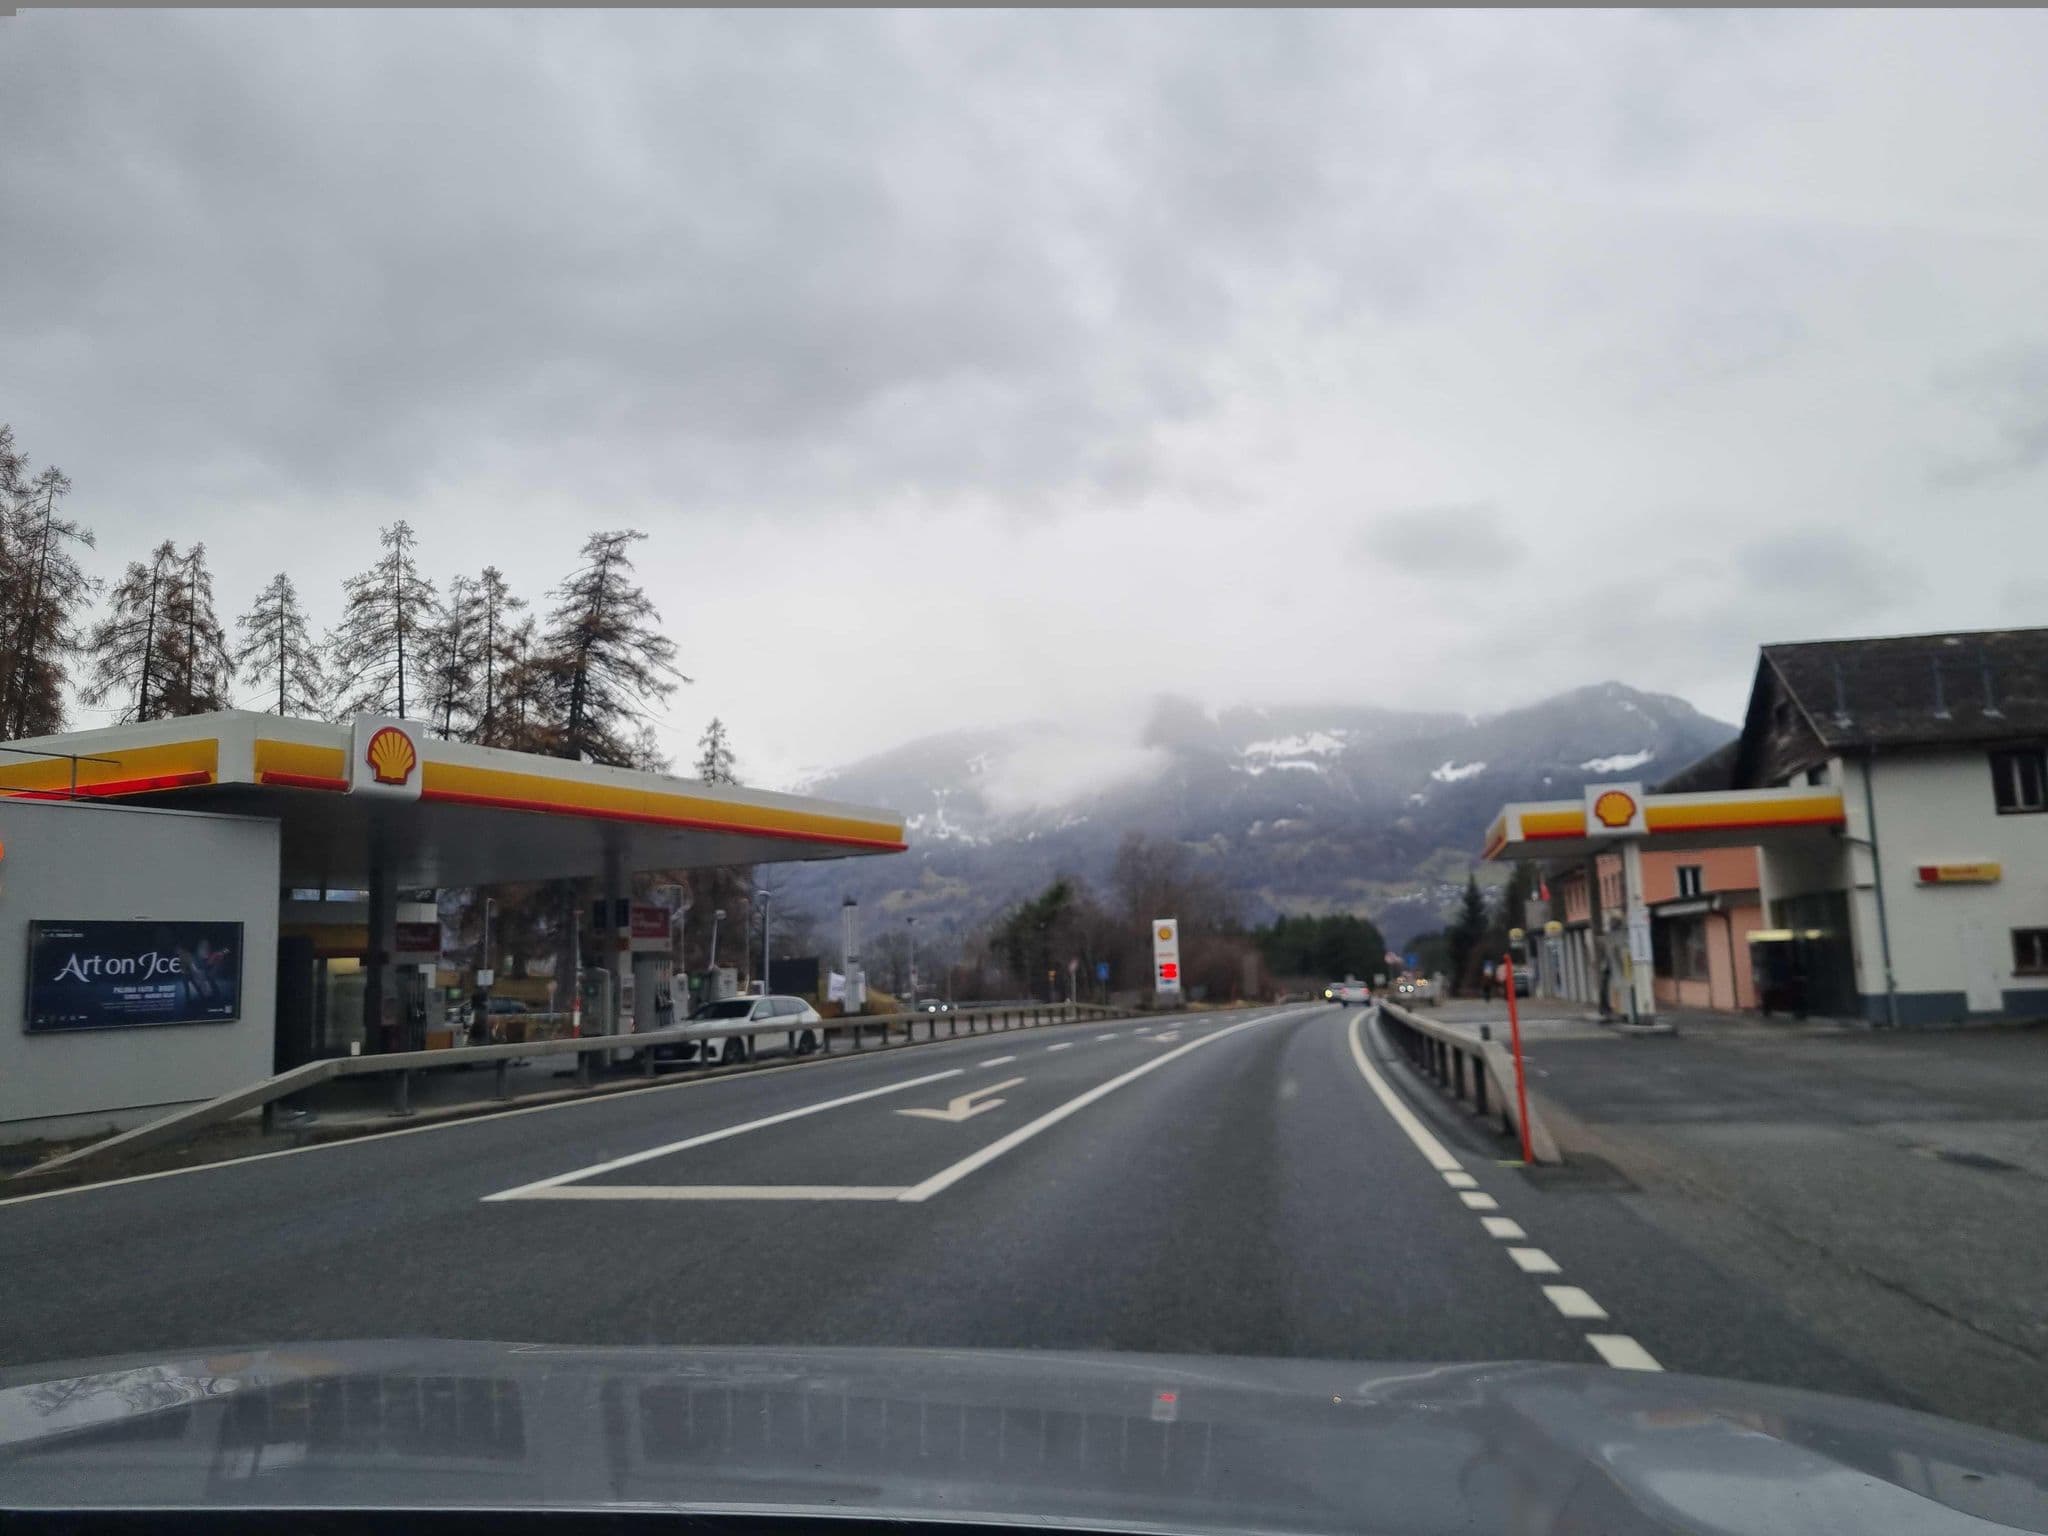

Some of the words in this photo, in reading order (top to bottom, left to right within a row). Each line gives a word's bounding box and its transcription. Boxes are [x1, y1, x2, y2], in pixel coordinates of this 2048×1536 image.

[54, 953, 102, 982] Art
[105, 958, 135, 975] on
[138, 951, 182, 981] Ice
